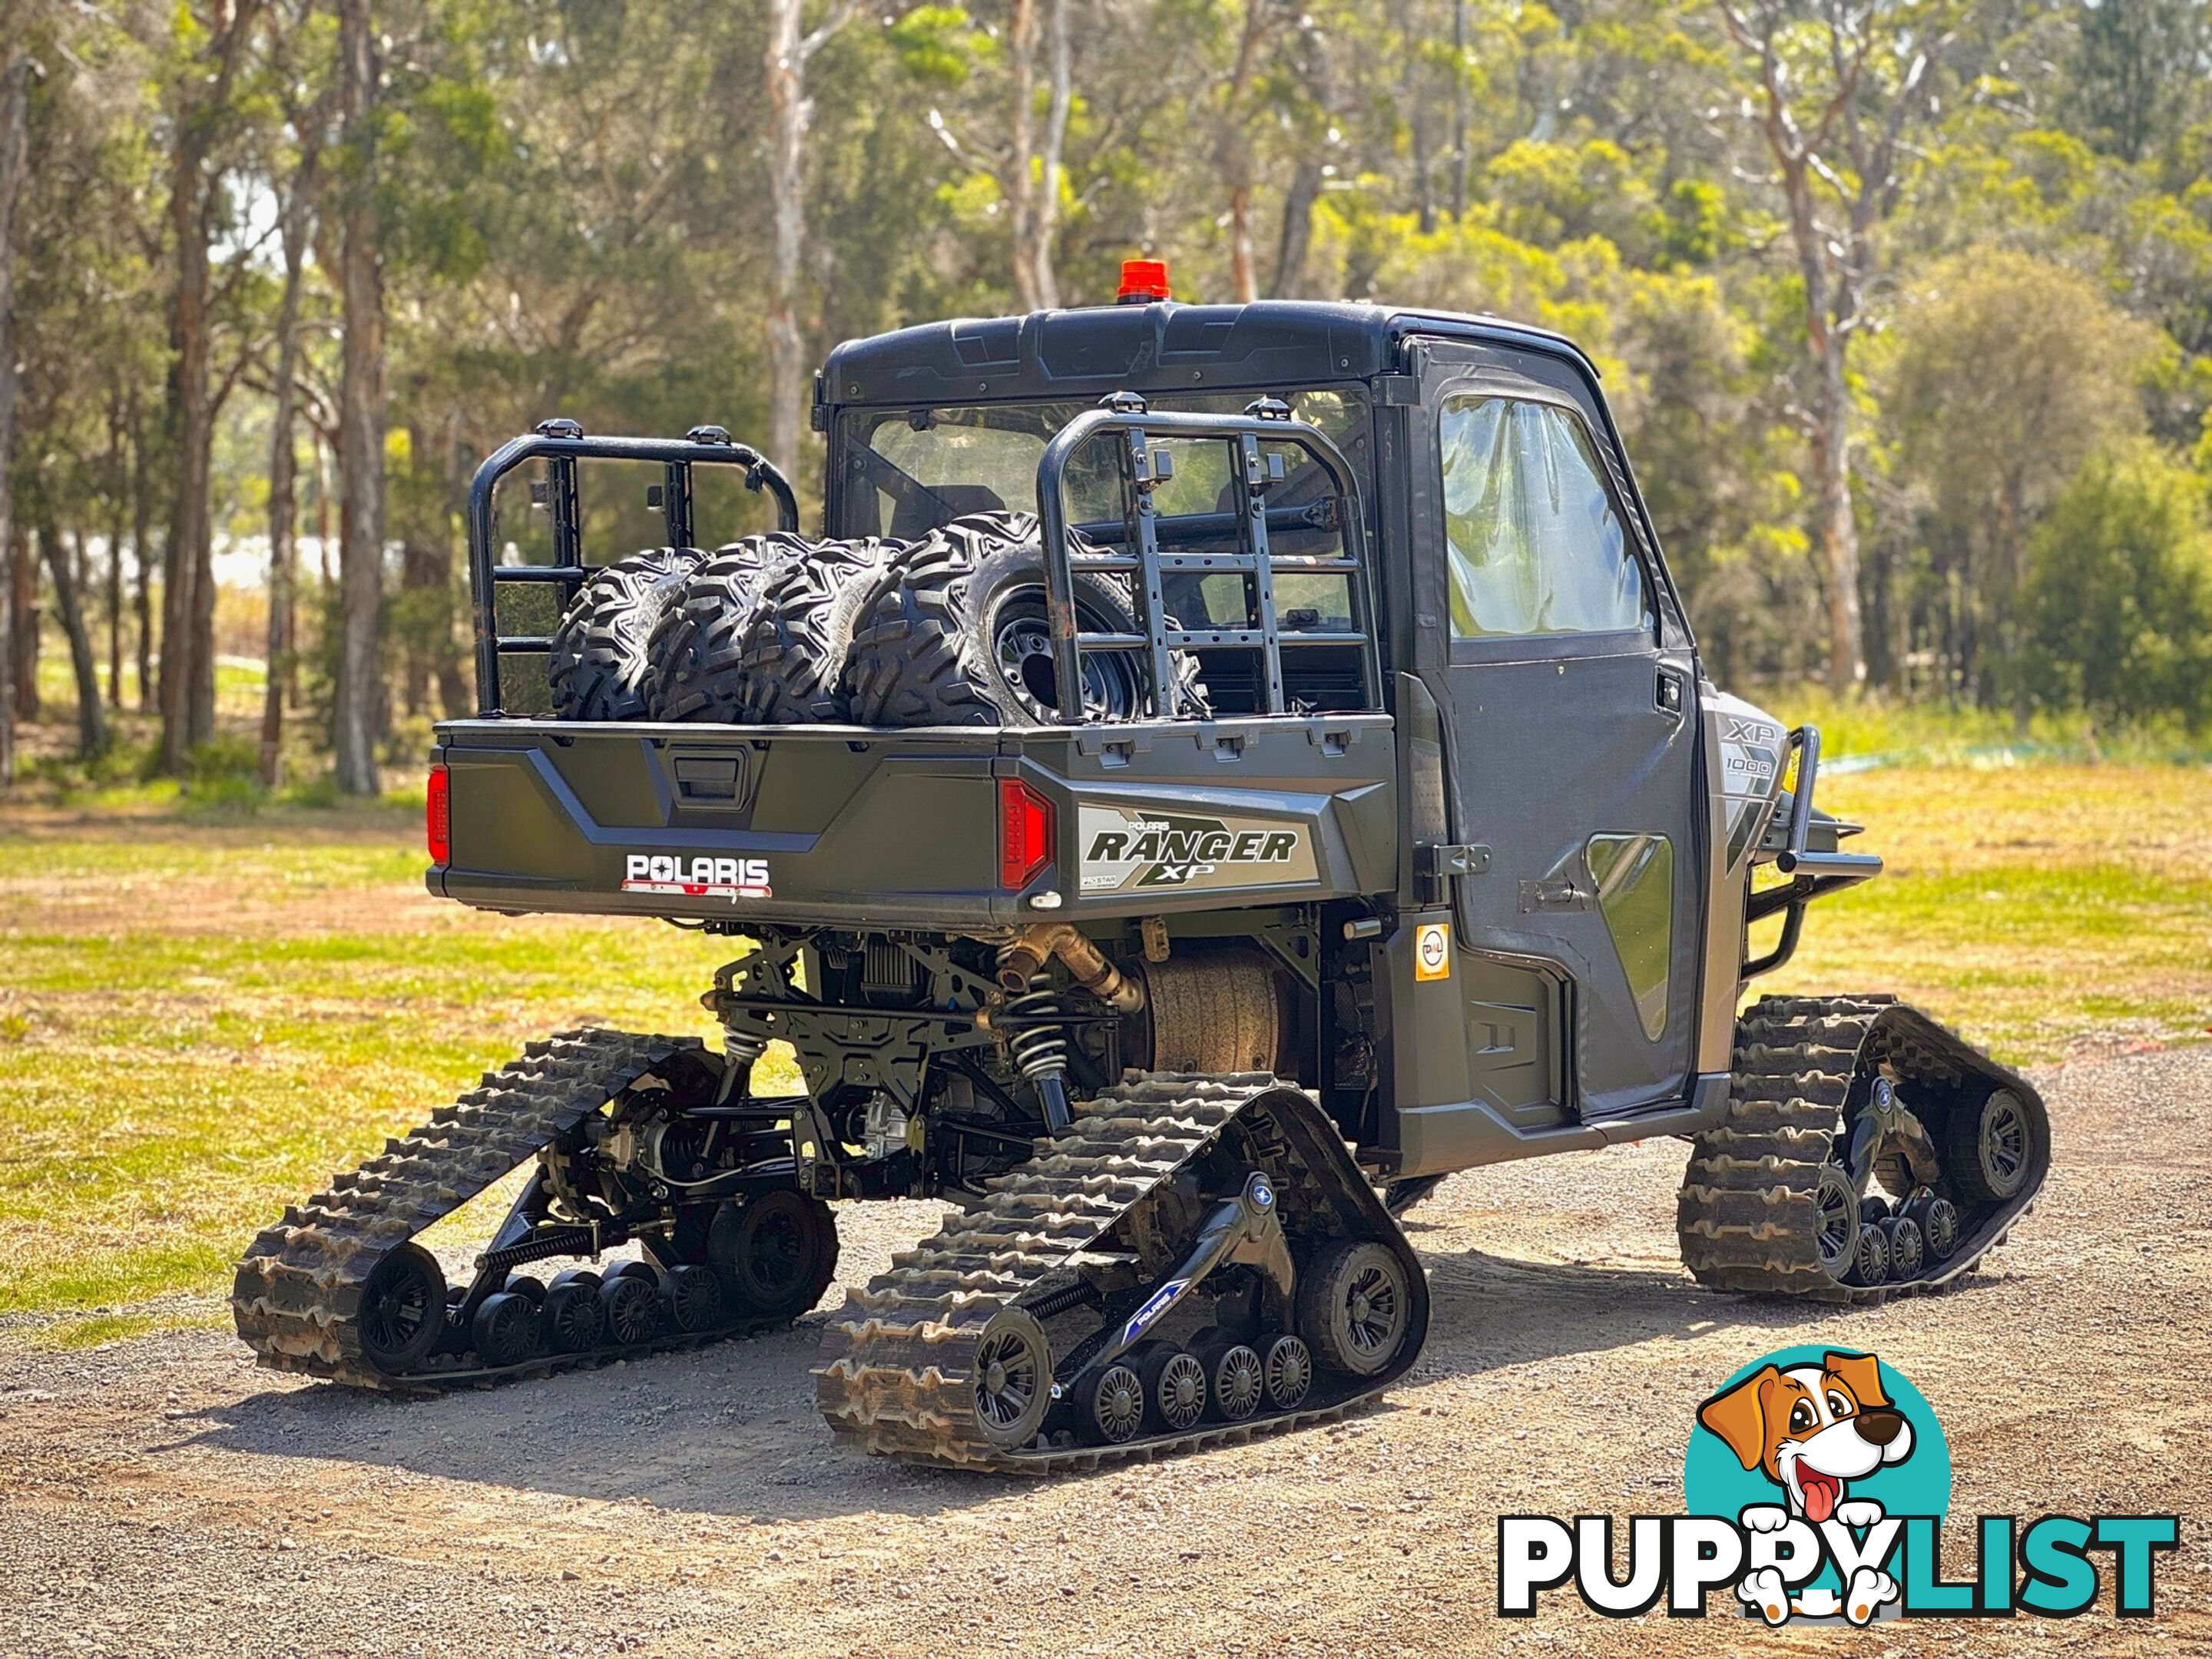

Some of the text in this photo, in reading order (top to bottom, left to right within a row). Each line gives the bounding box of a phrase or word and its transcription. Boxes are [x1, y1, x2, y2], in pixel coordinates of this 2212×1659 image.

[1723, 718, 1776, 744] XP
[1727, 757, 1771, 774] 1000
[1128, 821, 1170, 831] POLARIS
[1084, 830, 1298, 863] RANGER
[627, 855, 769, 885] POLARIS
[1155, 865, 1216, 879] XP
[1137, 1292, 1171, 1326] POLARIS
